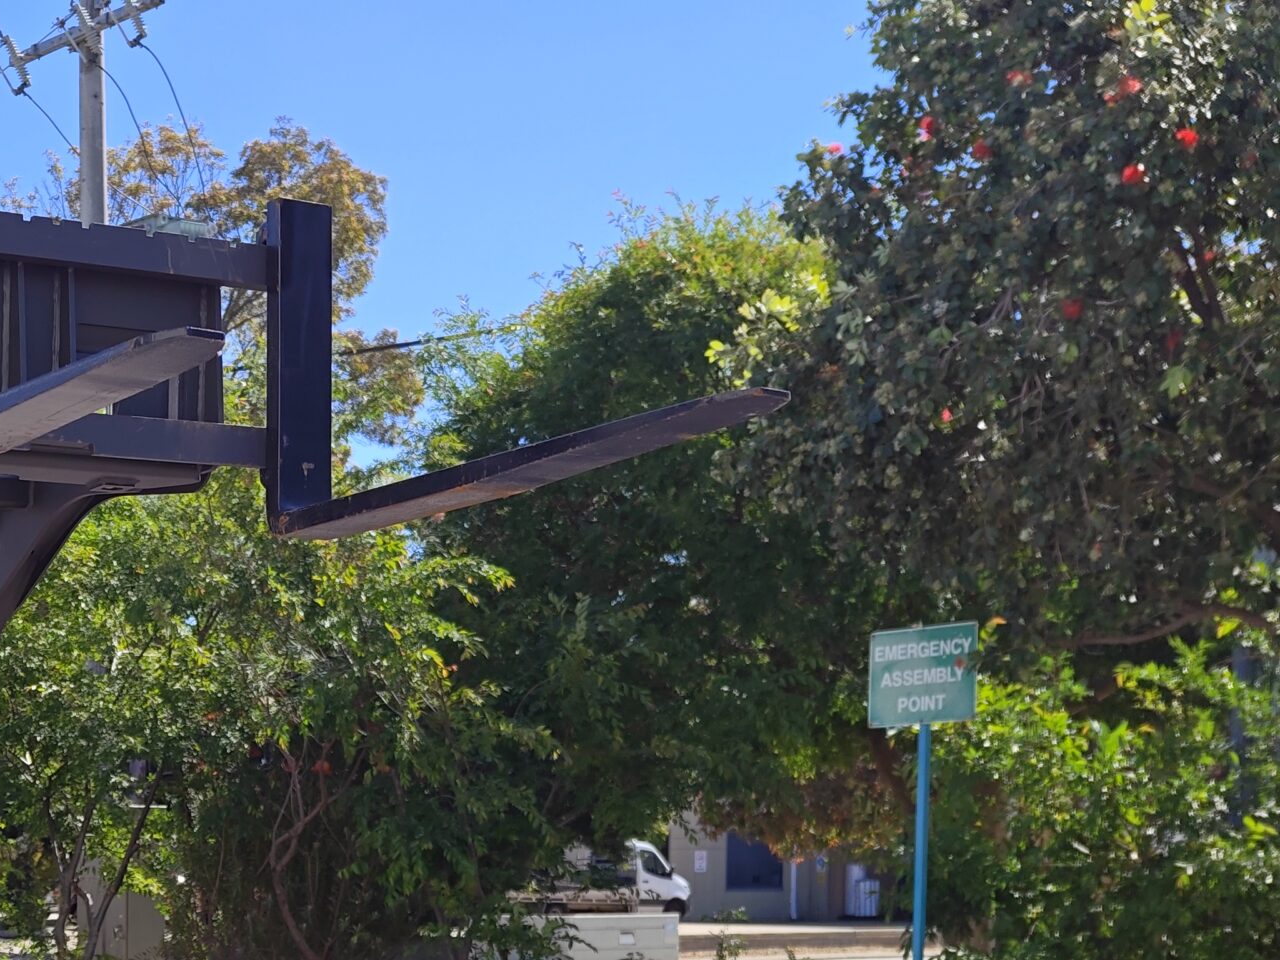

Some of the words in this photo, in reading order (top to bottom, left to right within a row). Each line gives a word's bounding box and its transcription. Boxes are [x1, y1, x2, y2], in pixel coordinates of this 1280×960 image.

[874, 637, 972, 662] EMERGENCY
[880, 666, 964, 688] ASSEMBLY
[897, 694, 946, 713] POINT
